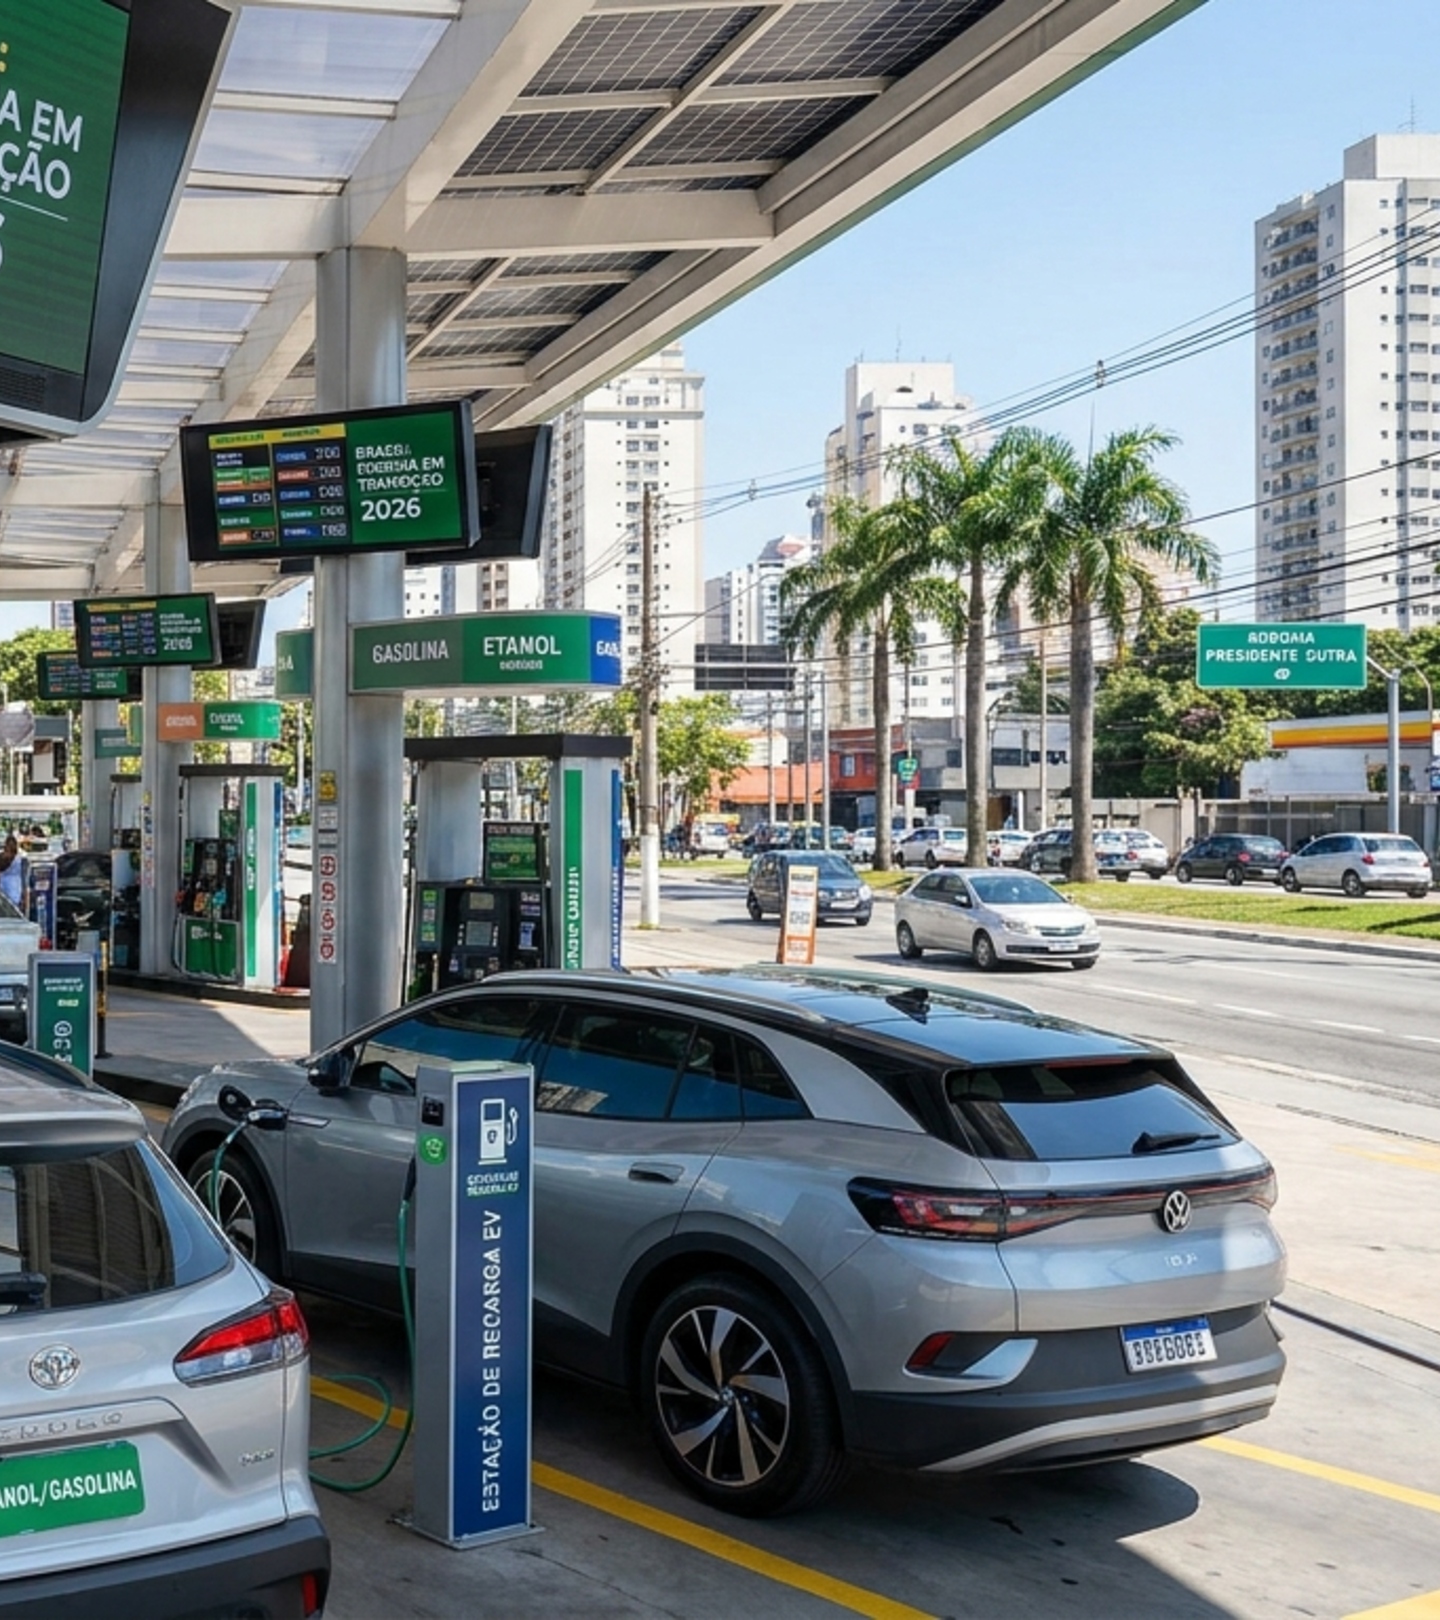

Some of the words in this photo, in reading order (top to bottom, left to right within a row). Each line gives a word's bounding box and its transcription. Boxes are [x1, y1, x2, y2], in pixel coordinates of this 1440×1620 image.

[31, 99, 84, 153] EM
[360, 497, 421, 522] 2026
[372, 639, 449, 663] GASOLINA
[1205, 649, 1298, 662] PRESIDENTE
[482, 1210, 502, 1241] EV
[482, 1367, 501, 1397] DE
